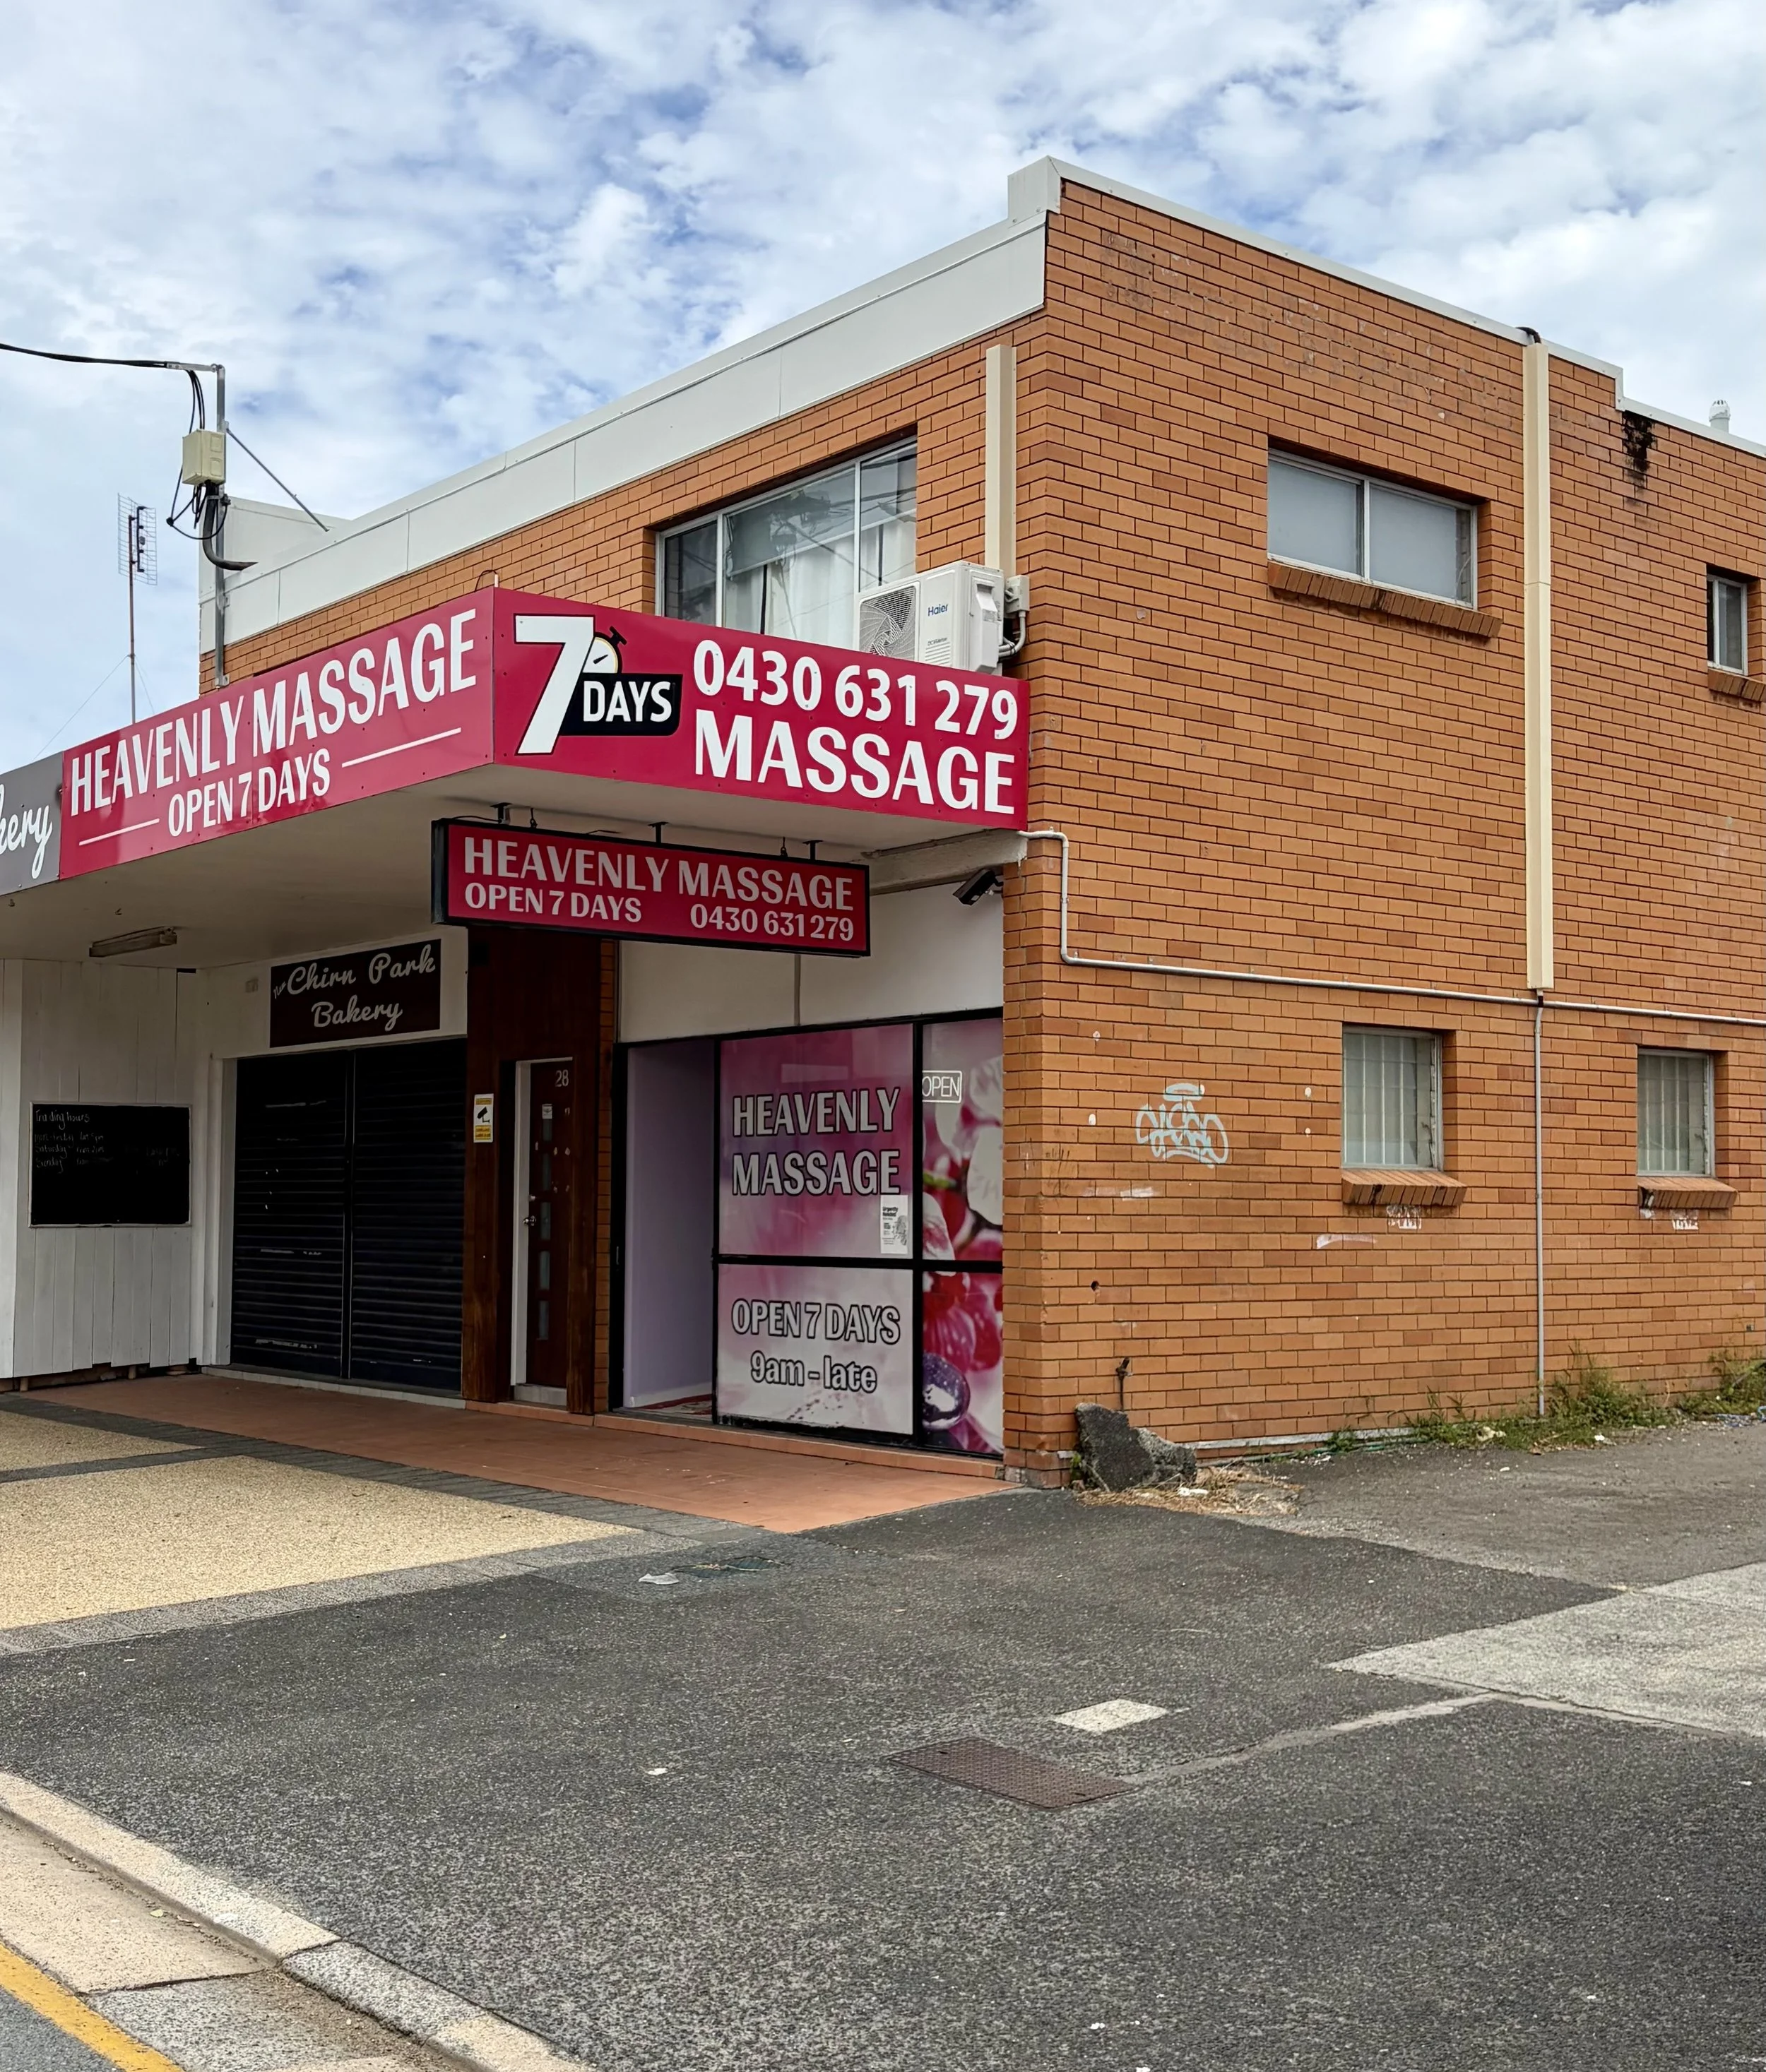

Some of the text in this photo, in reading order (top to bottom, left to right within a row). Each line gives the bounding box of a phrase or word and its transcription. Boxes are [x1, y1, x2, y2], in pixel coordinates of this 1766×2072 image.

[928, 604, 949, 617] Haier
[514, 614, 672, 754] 7 DAYS
[694, 639, 1018, 739] 0430 631 279
[71, 608, 476, 816] HEAVENLY MASSAGE
[695, 708, 1014, 814] MASSAGE
[168, 748, 331, 837] OPEN 7 DAYS
[465, 837, 853, 910] HEAVENLY MASSAGE
[465, 882, 641, 922] OPEN 7 DAYS
[690, 903, 853, 941] 0430 631 279
[287, 963, 357, 995] Chirn
[368, 944, 436, 984] Park
[310, 994, 403, 1032] Bakery
[555, 1069, 569, 1088] 28
[922, 1076, 961, 1098] OPEN
[733, 1087, 900, 1137] HEAVENLY
[732, 1148, 901, 1196] MASSAGE
[731, 1298, 901, 1345] OPEN 7 DAYS
[750, 1350, 805, 1386] 9am
[823, 1355, 877, 1393] late
